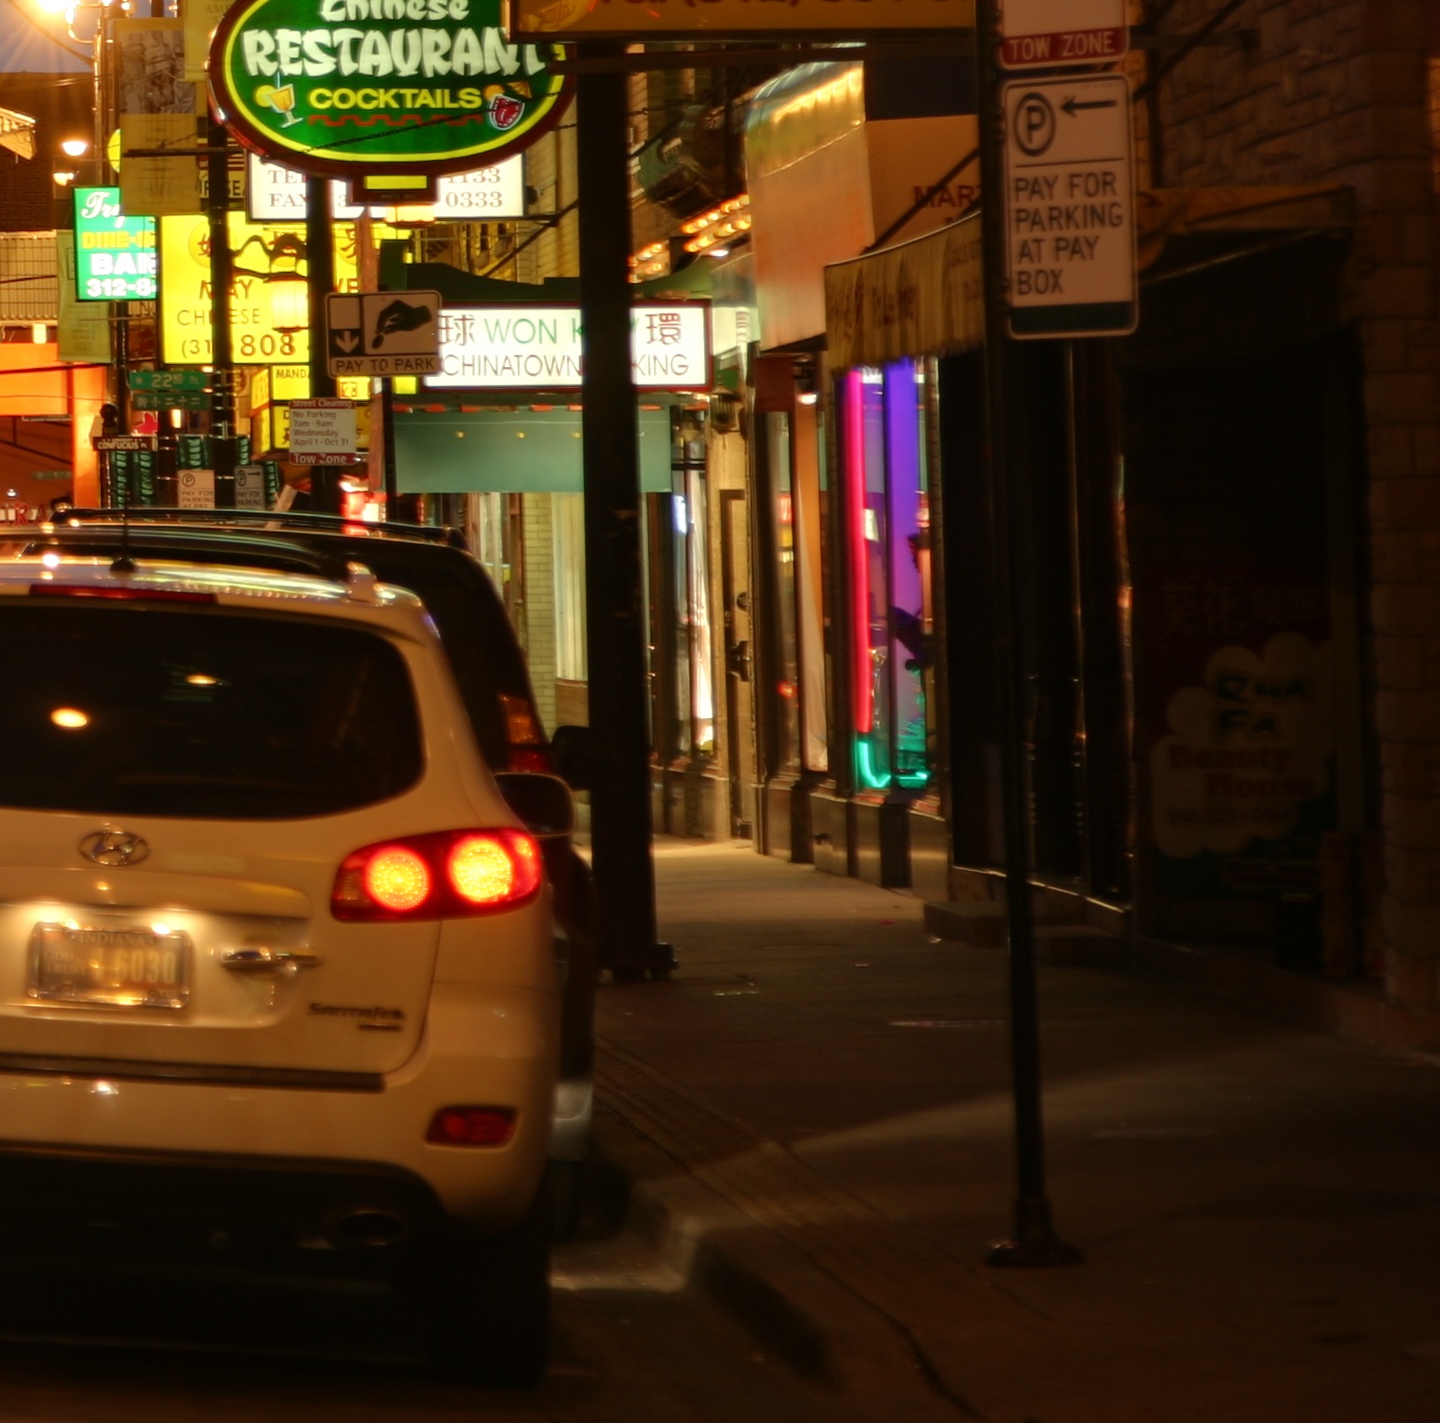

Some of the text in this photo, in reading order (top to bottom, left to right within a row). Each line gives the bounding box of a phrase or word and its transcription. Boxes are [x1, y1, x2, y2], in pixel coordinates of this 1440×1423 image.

[1010, 31, 1115, 60] TOW ZONE
[309, 87, 482, 110] COCKTAILS
[445, 191, 503, 208] 0333
[1015, 172, 1117, 202] PAY FOR
[1015, 203, 1123, 234] PARKING
[1019, 235, 1100, 264] AT PAY
[1017, 270, 1063, 295] BOX
[485, 318, 556, 344] WON
[336, 357, 435, 373] PAY TO PARK
[294, 453, 317, 464] Tow
[79, 933, 145, 945] INDIANA
